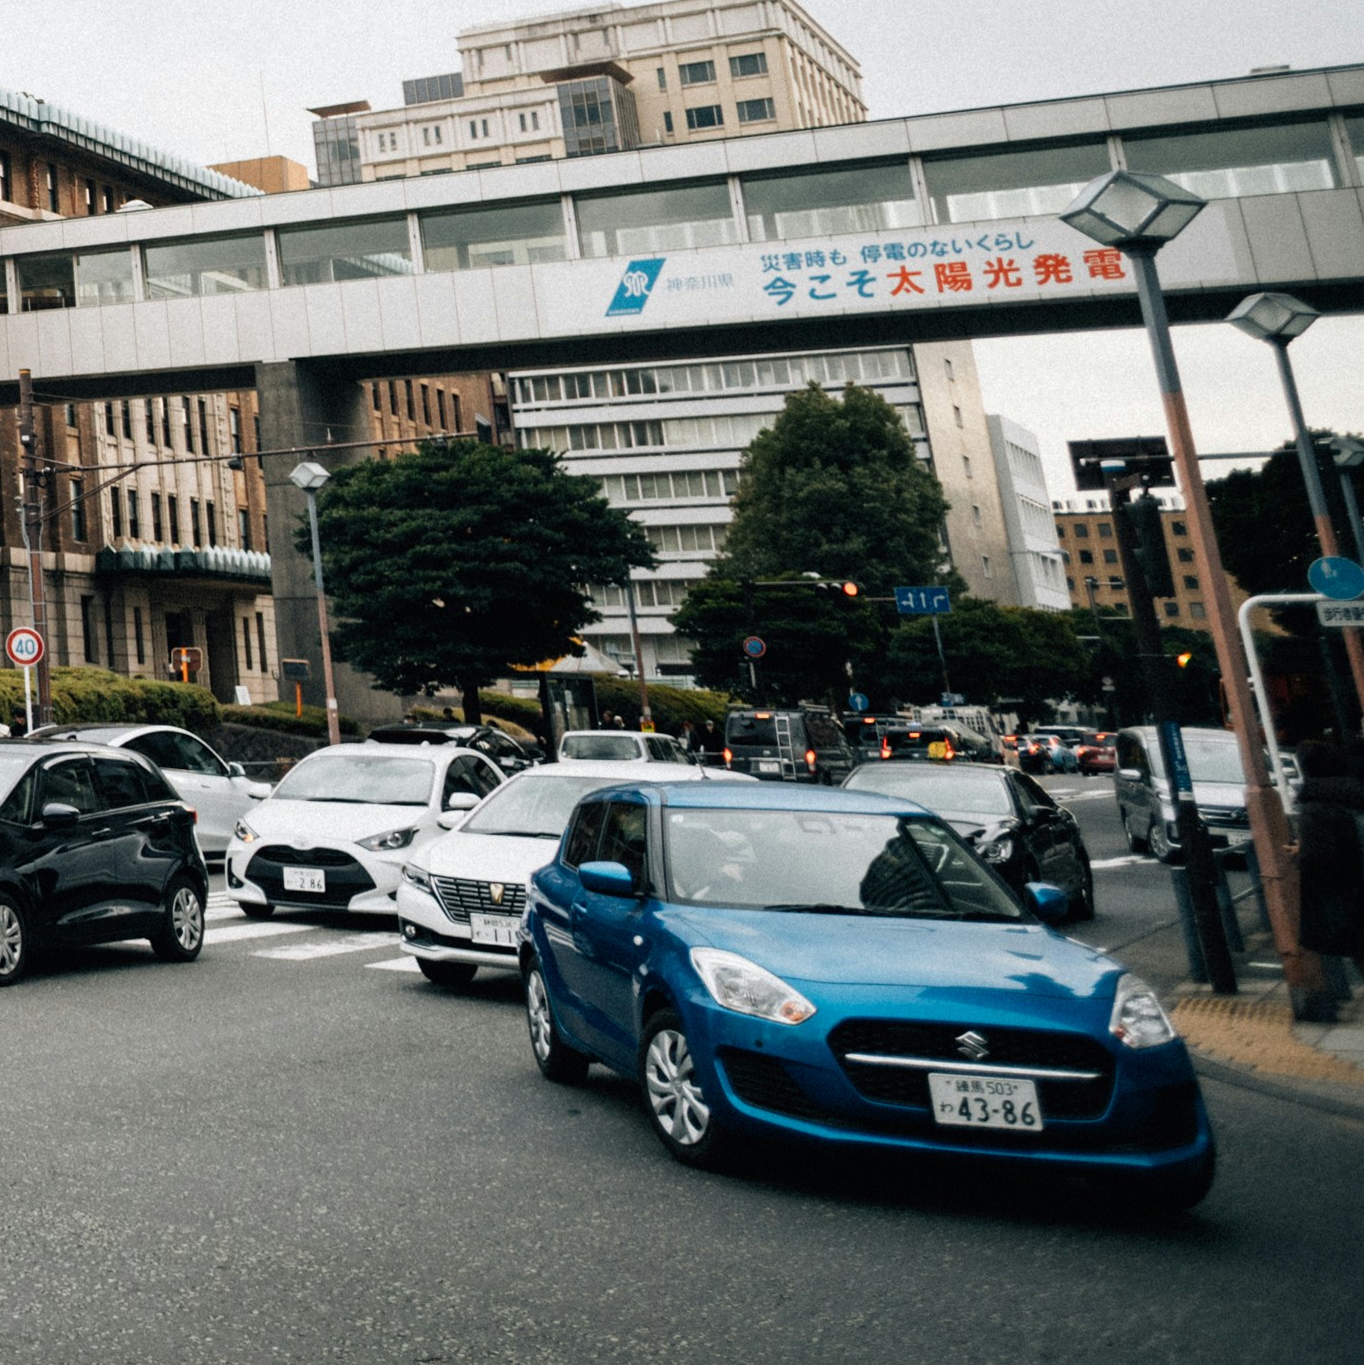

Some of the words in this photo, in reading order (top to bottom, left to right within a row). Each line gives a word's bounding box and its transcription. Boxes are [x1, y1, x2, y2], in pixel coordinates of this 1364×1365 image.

[760, 249, 847, 273] 災害時も
[861, 231, 1034, 264] 停電のないくらし
[666, 273, 734, 293] 神奈川県
[15, 639, 35, 655] 40
[939, 1101, 953, 1112] わ
[958, 1097, 1035, 1126] 43-86
